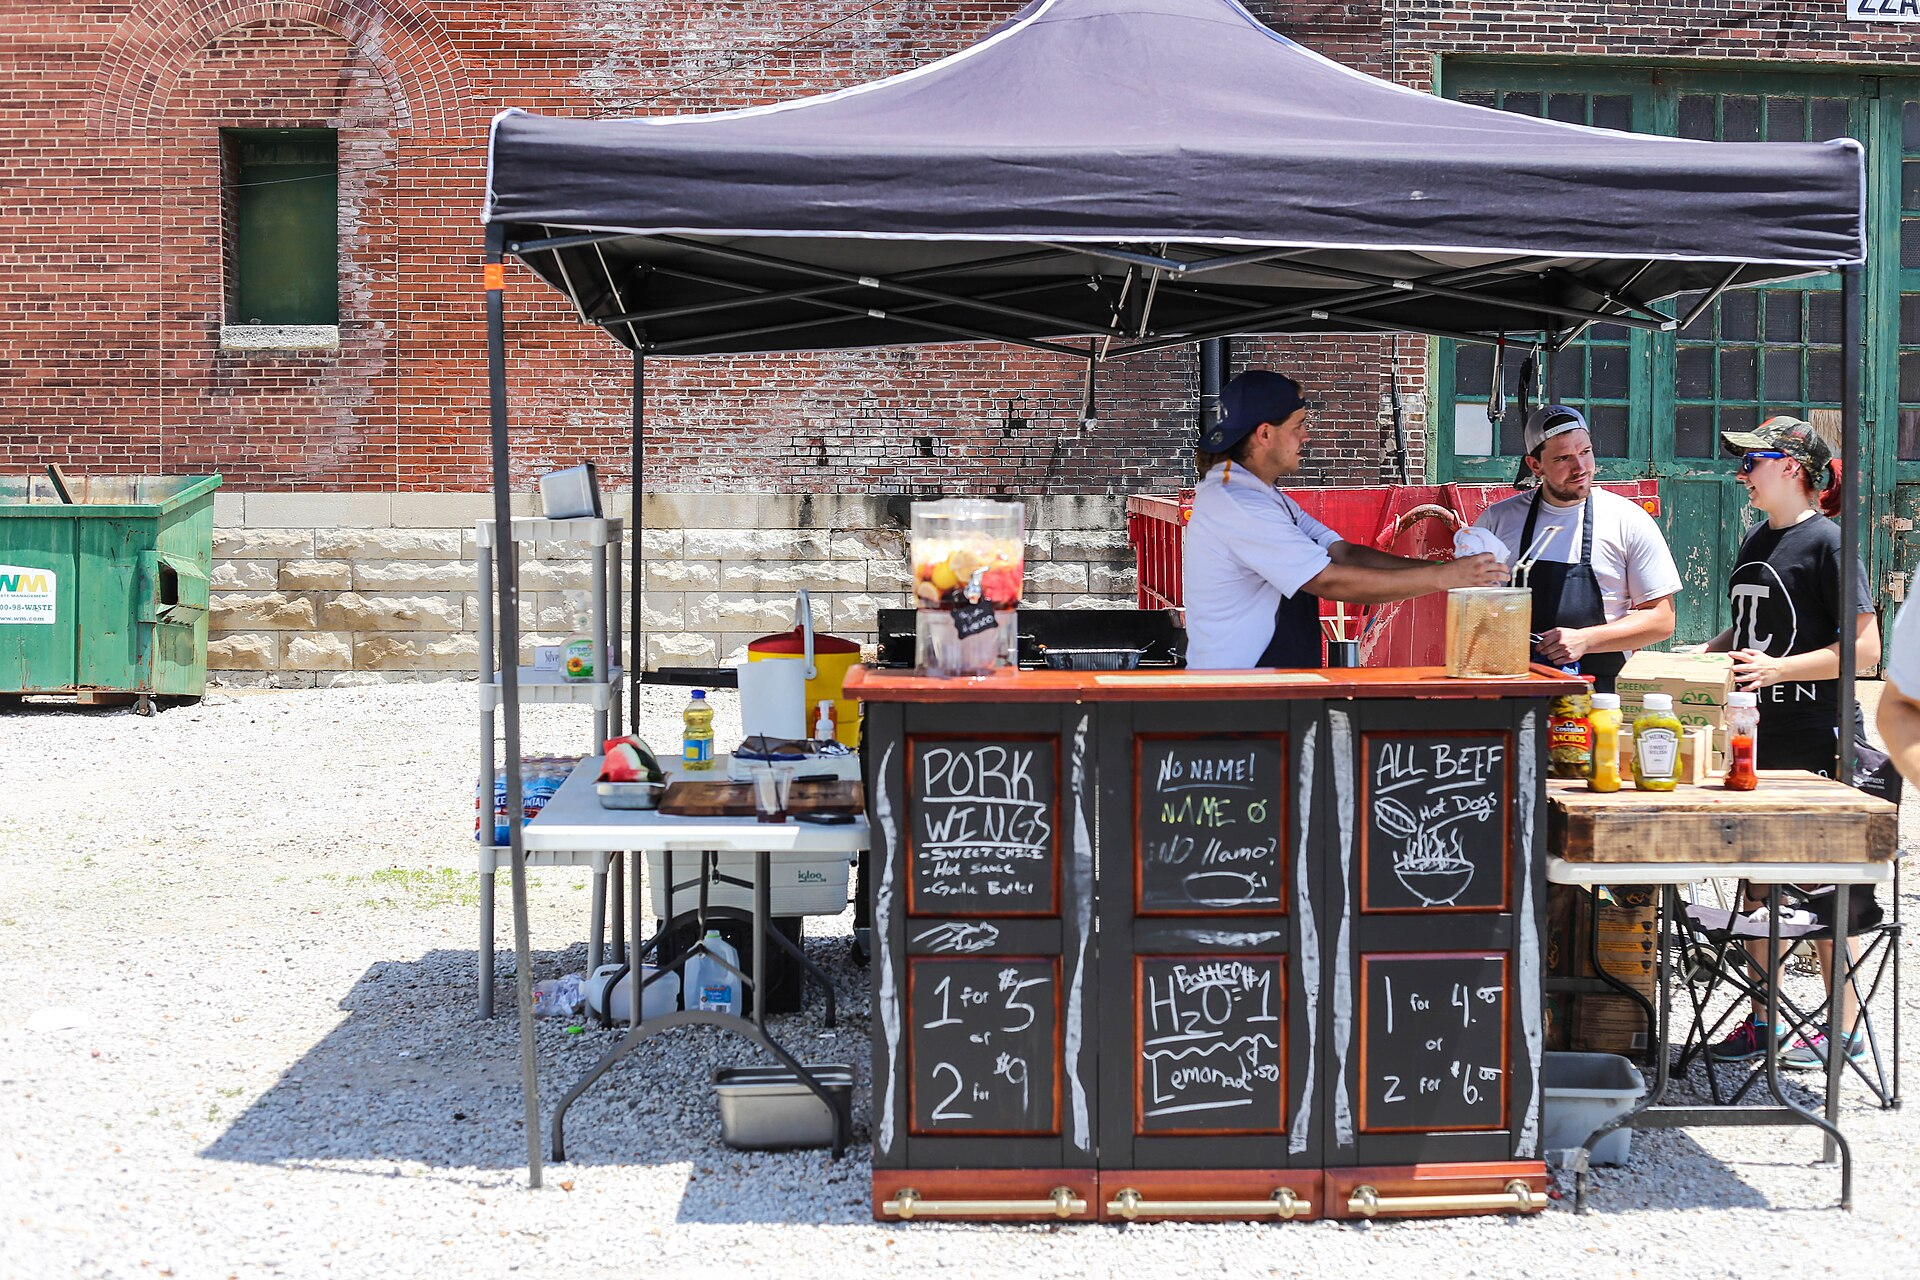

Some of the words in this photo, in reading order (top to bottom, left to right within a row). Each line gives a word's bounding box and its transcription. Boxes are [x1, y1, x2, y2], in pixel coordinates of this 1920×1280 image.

[1552, 735, 1586, 743] NACHOS
[923, 746, 1035, 800] PORK
[1376, 743, 1428, 786] ALL
[1430, 744, 1504, 782] BEEF
[1161, 795, 1236, 827] NAME
[1451, 792, 1498, 822] Dogs
[924, 805, 1050, 846] WINGS
[798, 870, 822, 881] igloo
[923, 976, 963, 1028] 1
[1384, 976, 1393, 1034] 1
[1425, 1037, 1444, 1051] or
[932, 1062, 973, 1120] 2
[1383, 1076, 1406, 1103] 2
